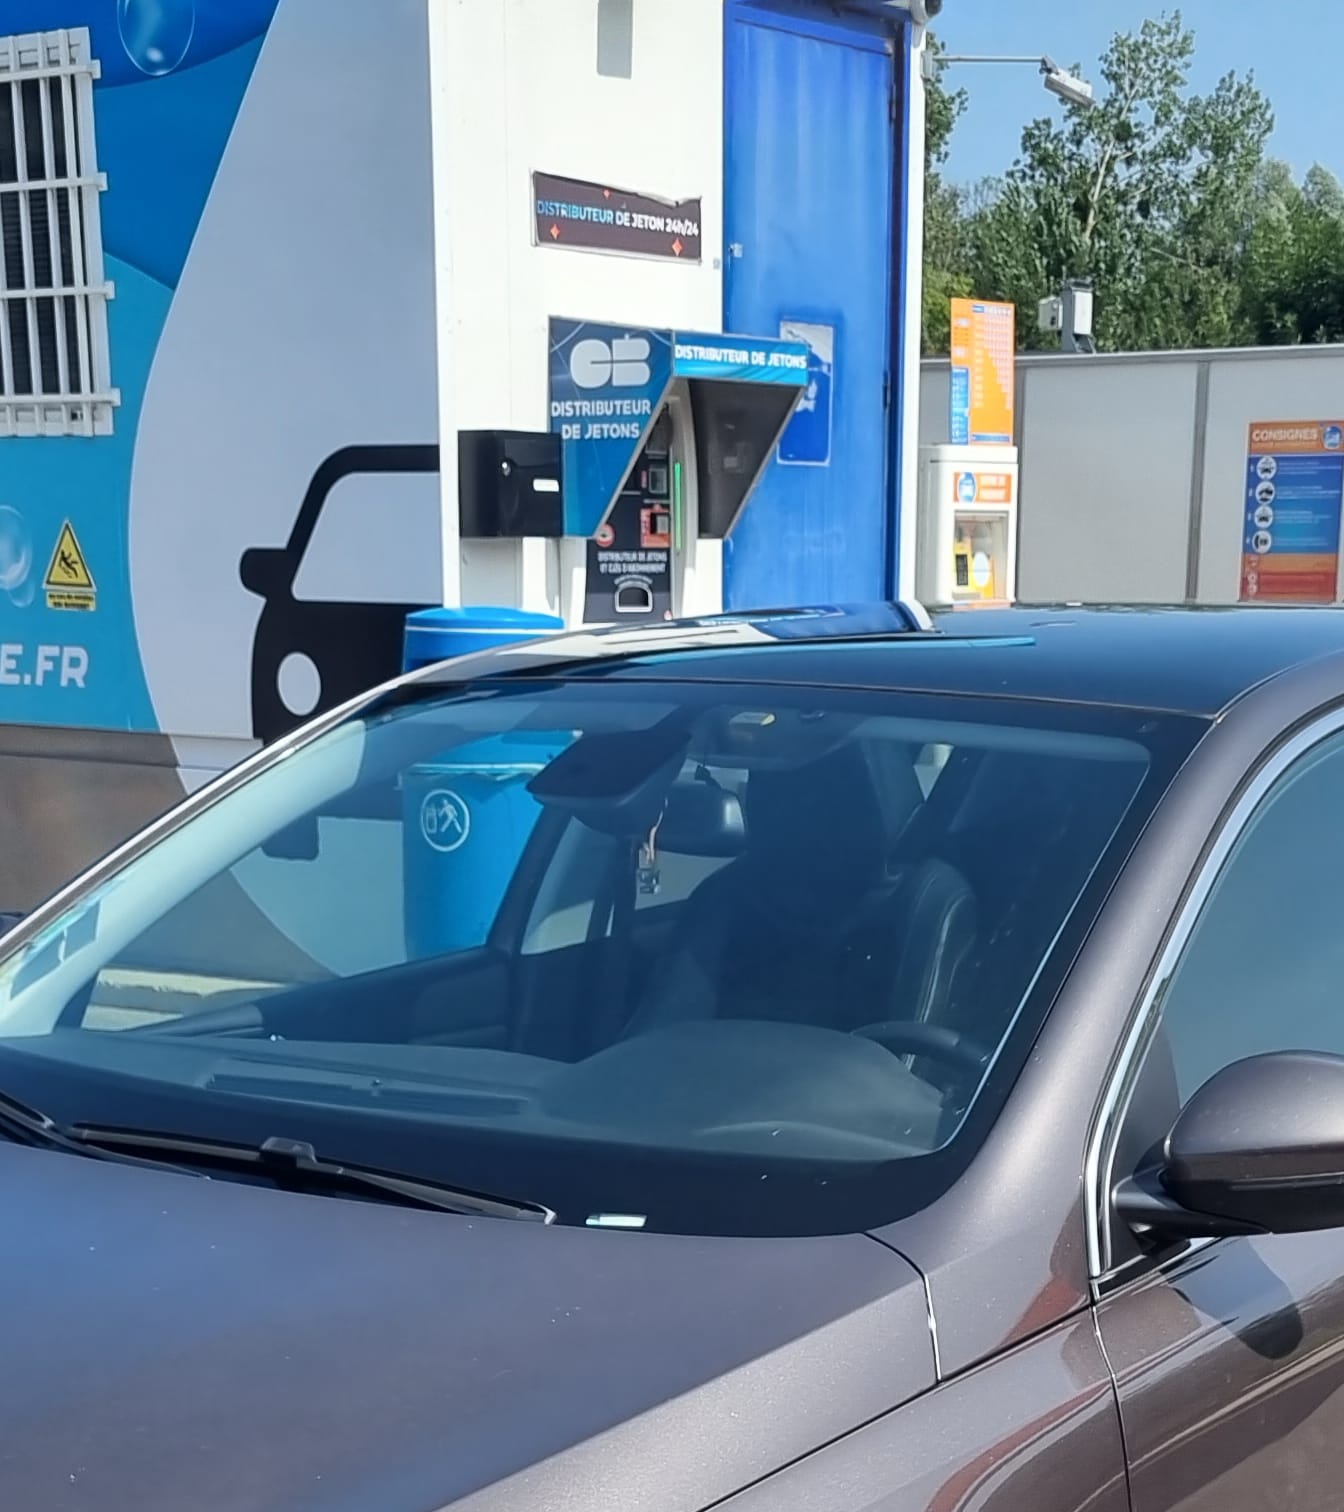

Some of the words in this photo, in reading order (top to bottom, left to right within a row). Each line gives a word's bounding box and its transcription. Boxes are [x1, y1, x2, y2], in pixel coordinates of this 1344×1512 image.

[537, 200, 613, 225] DISTRIBUTEUR
[615, 210, 630, 226] DE
[631, 212, 664, 232] JETON
[665, 216, 699, 237] 24h/24
[675, 344, 749, 365] DISTRIBUTEUR
[751, 351, 767, 366] DE
[768, 352, 807, 369] JETONS
[551, 399, 651, 417] DISTRIBUTEUR
[561, 423, 581, 440] DE
[584, 422, 640, 440] JETONS
